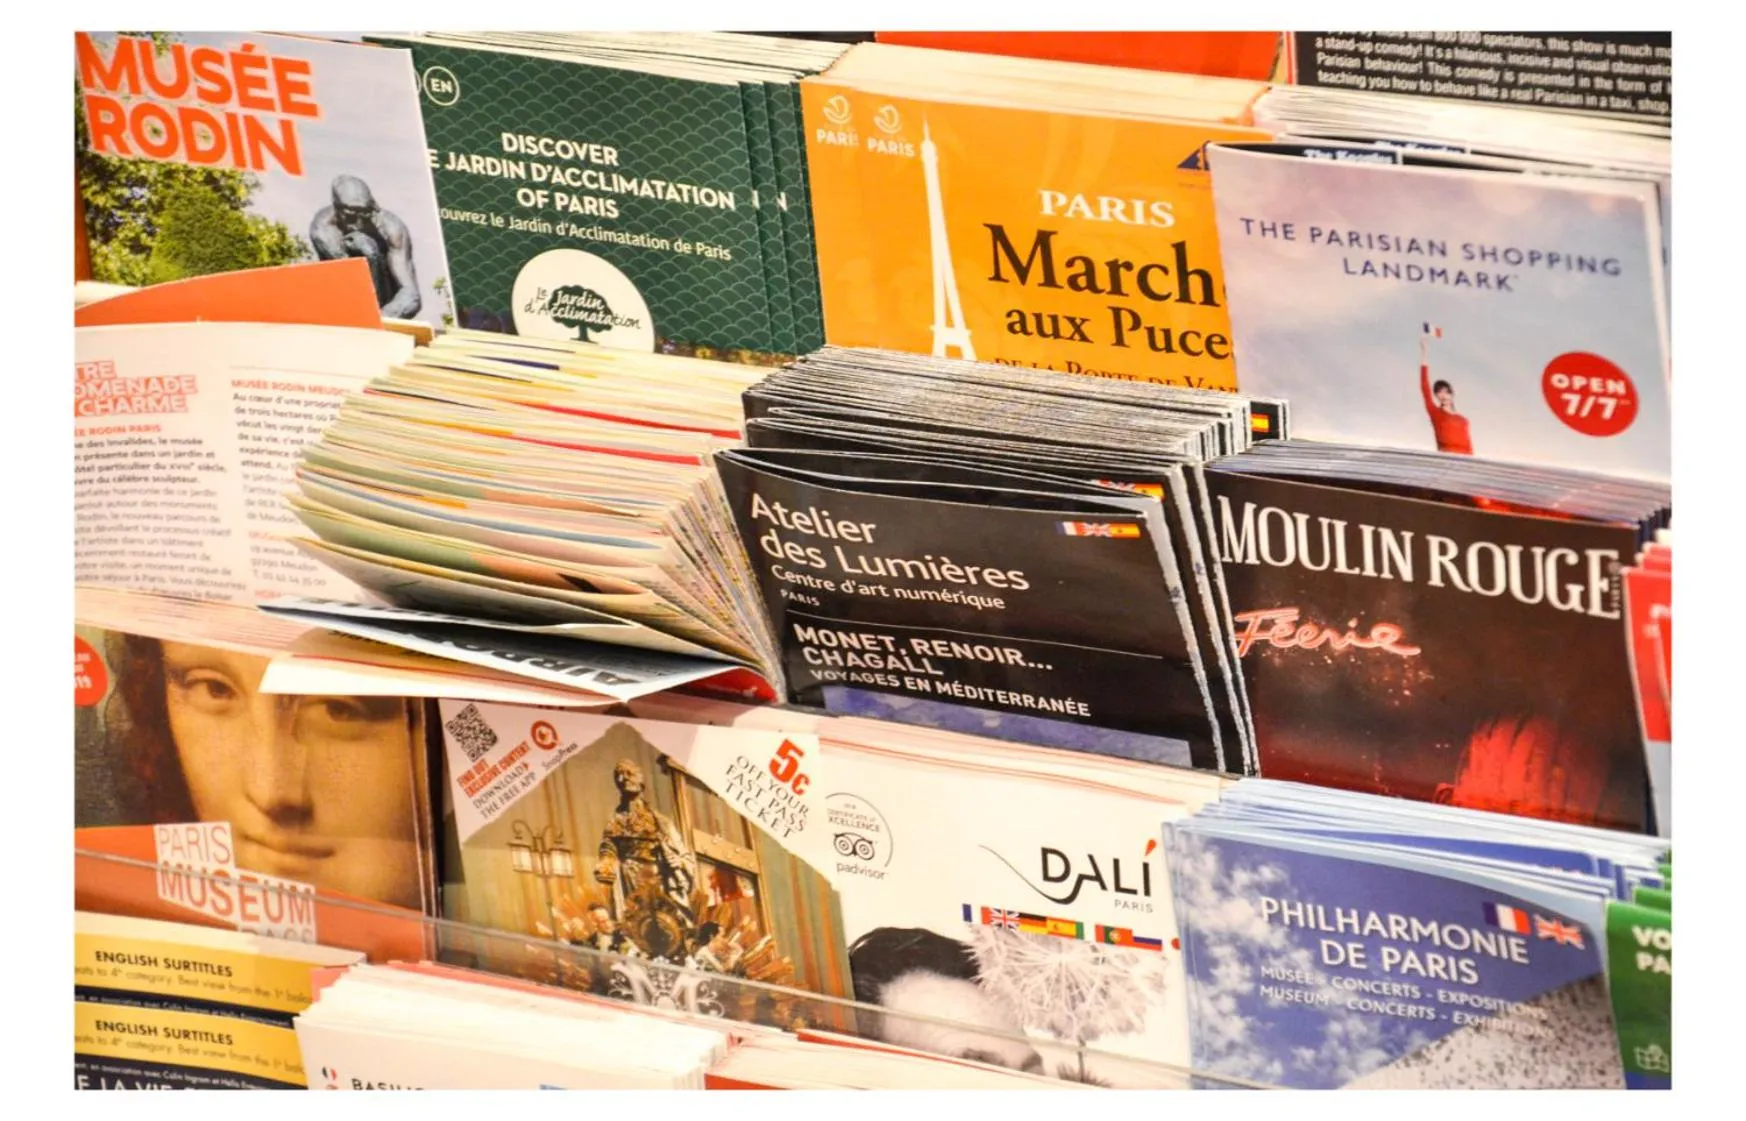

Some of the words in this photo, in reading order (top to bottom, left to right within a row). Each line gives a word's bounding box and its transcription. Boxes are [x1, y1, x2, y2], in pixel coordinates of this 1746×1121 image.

[1325, 37, 1373, 53] stand-up
[1552, 56, 1574, 69] and
[1576, 58, 1610, 72] visual
[1572, 39, 1604, 54] show
[1618, 44, 1652, 57] much
[75, 32, 318, 117] MUSÉE
[430, 78, 452, 94] EN
[1316, 52, 1361, 67] Parisian
[1428, 61, 1452, 76] This
[1455, 66, 1500, 83] comedy
[1503, 69, 1515, 82] is
[1517, 71, 1576, 87] presented
[1578, 75, 1591, 88] in
[1593, 76, 1614, 90] the
[1616, 78, 1646, 93] form
[1649, 81, 1663, 94] of
[1317, 70, 1367, 89] teaching
[1368, 76, 1390, 90] you
[1392, 74, 1418, 90] how
[1420, 79, 1432, 92] to
[1433, 79, 1476, 97] behave
[1478, 82, 1499, 98] like
[1510, 86, 1534, 102] real
[1535, 88, 1584, 104] Parisian
[1585, 93, 1598, 106] in
[84, 95, 304, 176] RODIN
[501, 132, 618, 167] DISCOVER
[867, 136, 915, 159] PARIS
[445, 152, 526, 181] JARDIN
[530, 164, 736, 211] D'ACCLIMATATION
[516, 187, 549, 208] OF
[554, 192, 619, 219] PARIS
[1039, 189, 1175, 229] PARIS
[437, 208, 486, 226] ouvrez
[490, 212, 504, 228] le
[508, 214, 552, 234] Jardin
[556, 221, 670, 252] d'Acclimatation
[674, 238, 691, 254] de
[696, 241, 732, 261] Paris
[1240, 217, 1296, 241] THE
[1310, 226, 1448, 258] PARISIAN
[1462, 243, 1623, 276] SHOPPING
[1343, 257, 1513, 292] LANDMARK
[1006, 308, 1094, 344] aux
[1550, 371, 1626, 395] OPEN
[79, 395, 188, 414] CHARME
[1560, 392, 1619, 421] 7/7
[88, 425, 126, 436] RODIN
[128, 423, 162, 433] PARIS
[751, 493, 877, 545] Atelier
[761, 529, 827, 569] des
[835, 546, 1030, 591] Lumières
[1217, 494, 1414, 582] MOULIN
[1426, 533, 1621, 620] ROUGE
[772, 564, 836, 592] Centre
[840, 577, 890, 598] d'art
[894, 585, 1006, 611] numérique
[780, 588, 820, 607] PARIS
[802, 646, 944, 677] CHAGALL
[911, 638, 1054, 671] RENOIR...
[810, 668, 900, 688] VOYAGES
[904, 676, 932, 692] EN
[936, 676, 1093, 718] MÉDITERRANÉE
[472, 764, 524, 809] DOWNLOAD
[480, 800, 501, 819] THE
[498, 783, 521, 805] FREE
[519, 771, 537, 788] APP
[726, 763, 766, 800] FAST
[768, 797, 805, 833] PASS
[735, 755, 767, 781] OFF
[767, 777, 810, 820] YOUR
[725, 778, 794, 839] TICKET
[159, 825, 232, 866] PARIS
[1041, 838, 1157, 905] DALÍ
[159, 861, 314, 925] MUSEUM
[1114, 898, 1154, 914] PARIS
[1260, 897, 1531, 966] PHILHARMONIE
[94, 949, 158, 969] ENGLISH
[162, 957, 233, 978] SURTITLES
[1320, 938, 1367, 969] DE
[1382, 946, 1480, 986] PARIS
[1260, 985, 1330, 1006] MUSEUM
[1346, 997, 1436, 1021] CONCERTS
[1332, 976, 1421, 1000] CONCERTS
[1437, 989, 1548, 1021] EXPOSITIONS
[94, 1019, 158, 1037] ENGLISH
[162, 1026, 233, 1047] SURTITLES
